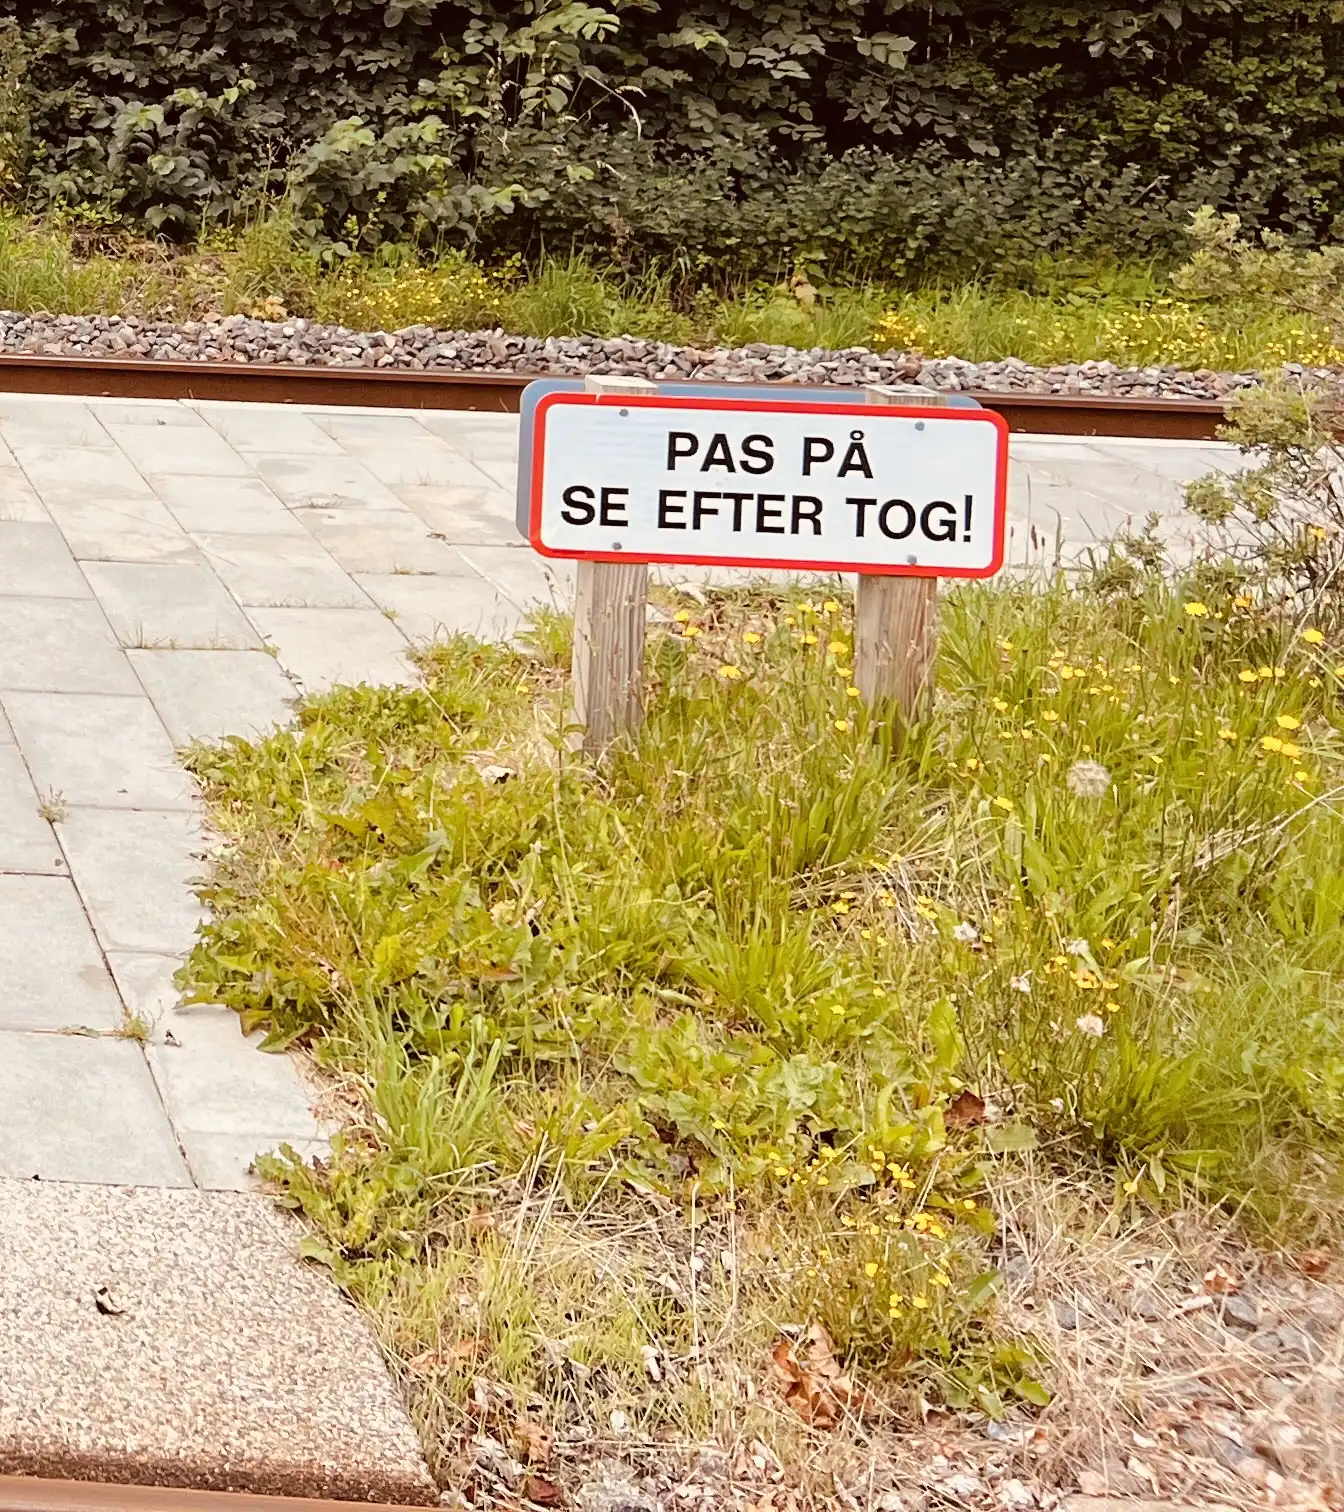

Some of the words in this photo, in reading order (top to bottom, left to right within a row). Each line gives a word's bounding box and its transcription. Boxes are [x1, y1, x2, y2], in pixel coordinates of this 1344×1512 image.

[666, 431, 775, 476] PAS
[801, 429, 875, 480] PÅ
[560, 485, 630, 527] SE
[657, 489, 823, 536] EFTER
[845, 494, 974, 544] TOG!
